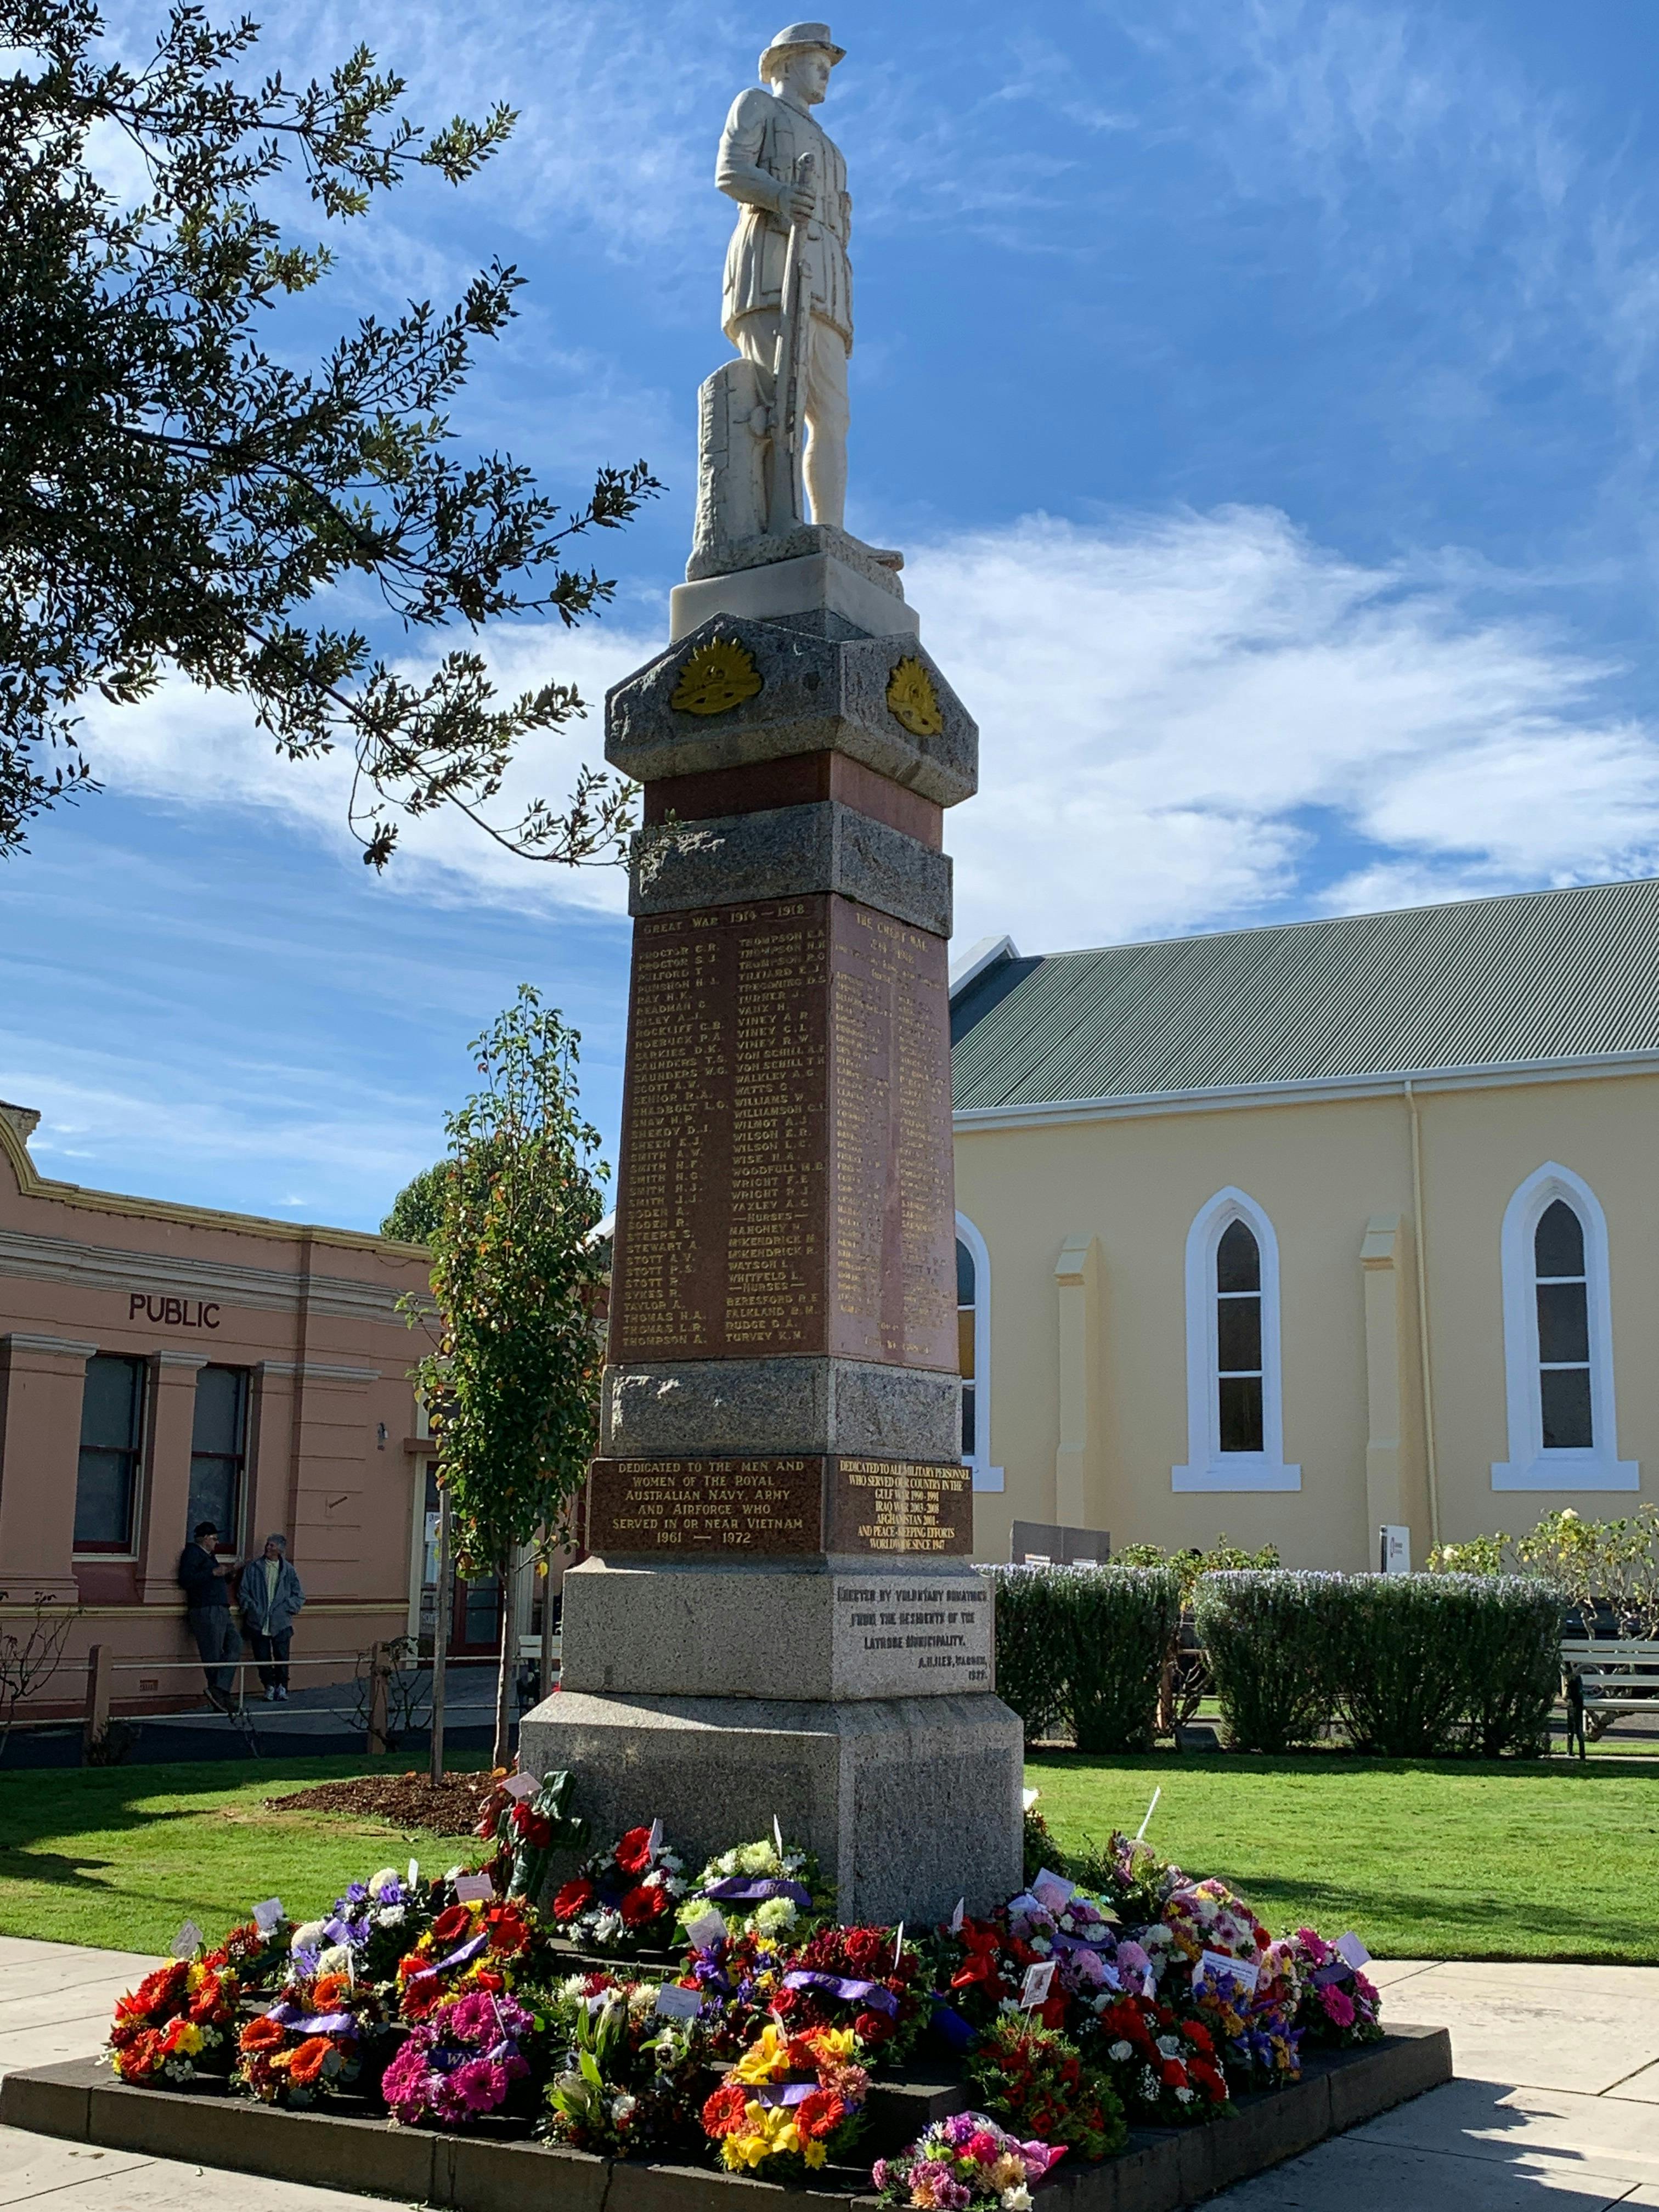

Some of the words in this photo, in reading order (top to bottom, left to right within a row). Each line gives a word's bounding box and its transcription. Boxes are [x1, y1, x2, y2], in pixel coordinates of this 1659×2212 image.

[643, 920, 682, 934] GREAT
[692, 915, 718, 928] WAR
[730, 909, 757, 923] 1914
[777, 903, 804, 917] 1918
[636, 957, 689, 972] PROCTOR
[637, 994, 659, 1005] RAY
[737, 990, 786, 1004] TURNER
[635, 1015, 670, 1026] RILEY
[737, 1014, 777, 1026] VINEY
[635, 1023, 693, 1038] ROCKLIFF
[737, 1025, 776, 1038] VINEY
[736, 1037, 775, 1049] VINEY
[736, 1051, 760, 1061] VON
[763, 1046, 803, 1058] SCHILL
[633, 1057, 697, 1071] SAUNDERS
[735, 1062, 759, 1073] VON
[763, 1057, 803, 1070] SCHILL
[633, 1068, 698, 1083] SAUNDERS
[735, 1071, 786, 1084] WALKLEY
[633, 1082, 668, 1093] SCOTT
[735, 1083, 773, 1096] WATTS
[733, 1093, 788, 1108] WILLIAMS
[733, 1104, 802, 1119] WILLIAMSON
[631, 1116, 664, 1128] SHAW
[732, 1118, 777, 1130] WILMOT
[732, 1130, 778, 1142] WILSON
[631, 1139, 671, 1150] SHEEN
[732, 1141, 778, 1153] WILSON
[630, 1151, 667, 1163] SMITH
[731, 1154, 763, 1165] WISE
[629, 1162, 667, 1173] SMITH
[731, 1163, 797, 1177] WOODFULL
[629, 1173, 666, 1184] SMITH
[731, 1176, 779, 1189] WRIGHT
[629, 1184, 665, 1196] SMITH
[730, 1188, 779, 1200] WRIGHT
[628, 1197, 664, 1207] SMITH
[730, 1200, 777, 1212] YAXLEY
[627, 1207, 668, 1220] SODEN
[628, 1219, 668, 1230] SODEN
[729, 1223, 787, 1235] MAHONEY
[626, 1230, 676, 1242] STEERS
[626, 1242, 682, 1254] STEWART
[626, 1254, 663, 1265] STOTT
[727, 1260, 777, 1271] WATSON
[625, 1266, 663, 1277] STOTT
[624, 1277, 663, 1288] STOTT
[624, 1289, 663, 1300] SYKES
[725, 1294, 793, 1306] BERESFORD
[129, 1293, 220, 1329] PUBLIC
[623, 1300, 667, 1311] TAYLOR
[623, 1312, 674, 1323] THOMAS
[725, 1306, 785, 1319] FALKLAND
[622, 1324, 673, 1335] THOMAS
[725, 1319, 766, 1331] RUDGE
[622, 1335, 687, 1347] THOMPSON
[725, 1331, 772, 1342] TURVEY
[619, 1463, 680, 1473] DEDICATED
[688, 1462, 702, 1472] TO
[709, 1462, 731, 1472] THE
[741, 1462, 768, 1471] MEN
[776, 1461, 804, 1471] AND
[840, 1460, 879, 1474] DEDICATED
[879, 1463, 889, 1474] TO
[890, 1464, 902, 1475] ALL
[935, 1467, 970, 1480] PERSONNEL
[633, 1476, 675, 1487] WOMEN
[682, 1476, 697, 1487] OF
[704, 1476, 726, 1487] THE
[735, 1475, 775, 1486] ROYAL
[849, 1474, 866, 1486] WHO
[867, 1475, 894, 1487] SERVED
[895, 1476, 909, 1488] OUR
[911, 1478, 940, 1490] COUNTRY
[941, 1480, 949, 1491] IN
[949, 1480, 963, 1491] THE
[625, 1490, 701, 1500] AUSTRALIAN
[754, 1489, 790, 1500] ARMY
[875, 1488, 894, 1499] GULF
[894, 1488, 910, 1500] WAR
[911, 1490, 923, 1501] 1990
[927, 1491, 939, 1502] 1991
[637, 1505, 663, 1515] AND
[673, 1504, 732, 1515] AIRFORCE
[742, 1504, 771, 1514] WHO
[875, 1500, 893, 1514] IRAQ
[894, 1501, 909, 1513] WAR
[613, 1519, 658, 1529] SERVED
[664, 1519, 678, 1528] IN
[684, 1519, 698, 1528] OR
[705, 1519, 738, 1528] NEAR
[747, 1517, 803, 1529] VIETNAM
[876, 1513, 923, 1526] AFGHANISTAN
[657, 1532, 681, 1543] 1961
[723, 1532, 751, 1543] 1972
[858, 1525, 873, 1537] AND
[927, 1527, 955, 1538] EFFORTS
[870, 1537, 912, 1549] WORLDWIDE
[912, 1539, 931, 1550] SINCE
[879, 1589, 891, 1601] BY
[895, 1589, 944, 1602] VOLUNTARY
[850, 1613, 877, 1627] FROM
[880, 1613, 896, 1624] THE
[948, 1612, 958, 1624] OF
[961, 1612, 975, 1624] THE
[865, 1637, 903, 1650] LATROBE
